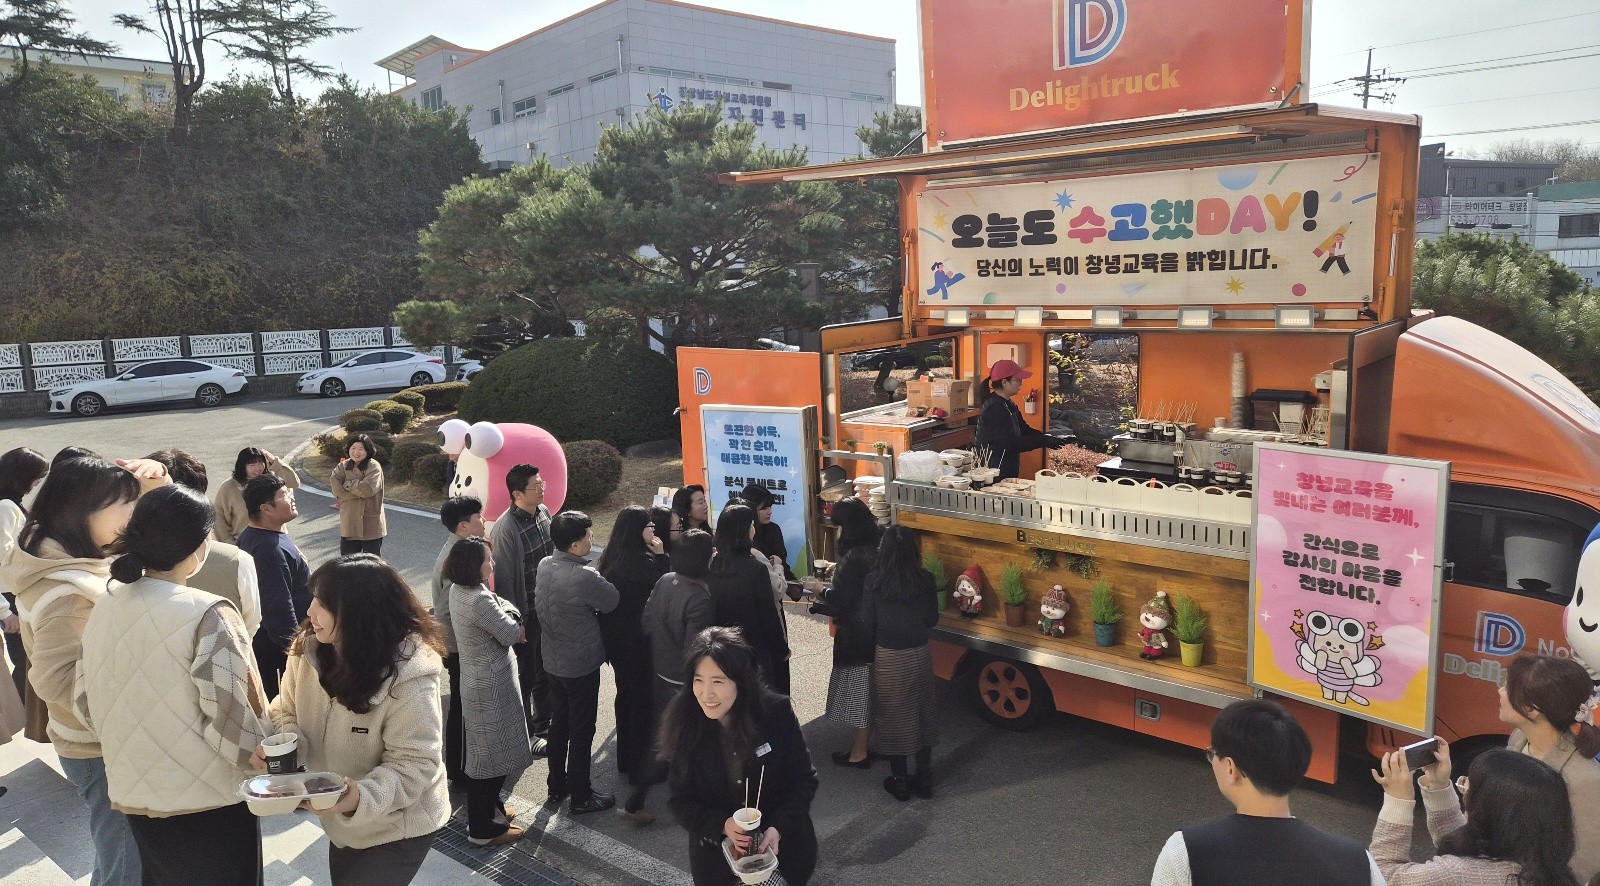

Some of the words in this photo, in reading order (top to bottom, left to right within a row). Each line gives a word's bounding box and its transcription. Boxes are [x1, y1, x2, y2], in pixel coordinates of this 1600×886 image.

[1009, 63, 1180, 111] Delightruck
[952, 209, 1057, 248] 오늘도
[1067, 190, 1319, 244] 수고했DAY!
[1465, 202, 1501, 212] 타이어테크
[976, 258, 1023, 277] 당신의
[1029, 256, 1079, 276] 노력이
[1085, 252, 1179, 274] 창녕교육을
[1186, 248, 1277, 272] 밝힙니다.
[724, 424, 754, 436] 뜨끈한
[757, 426, 780, 438] 어묵,
[721, 453, 750, 465] 매콤한
[753, 455, 788, 467] 떡볶이!
[741, 439, 751, 450] 찬
[754, 440, 777, 453] 순대,
[724, 476, 744, 488] 분식
[1296, 472, 1394, 501] 창녕교육을
[1273, 490, 1327, 513] 빛내는
[1333, 500, 1419, 528] 여러분께,
[1303, 533, 1380, 561] 간식으로
[1283, 550, 1337, 574] 감사의
[1341, 562, 1402, 587] 마음을
[1299, 574, 1381, 605] 전합니다.
[1443, 653, 1508, 687] Deli
